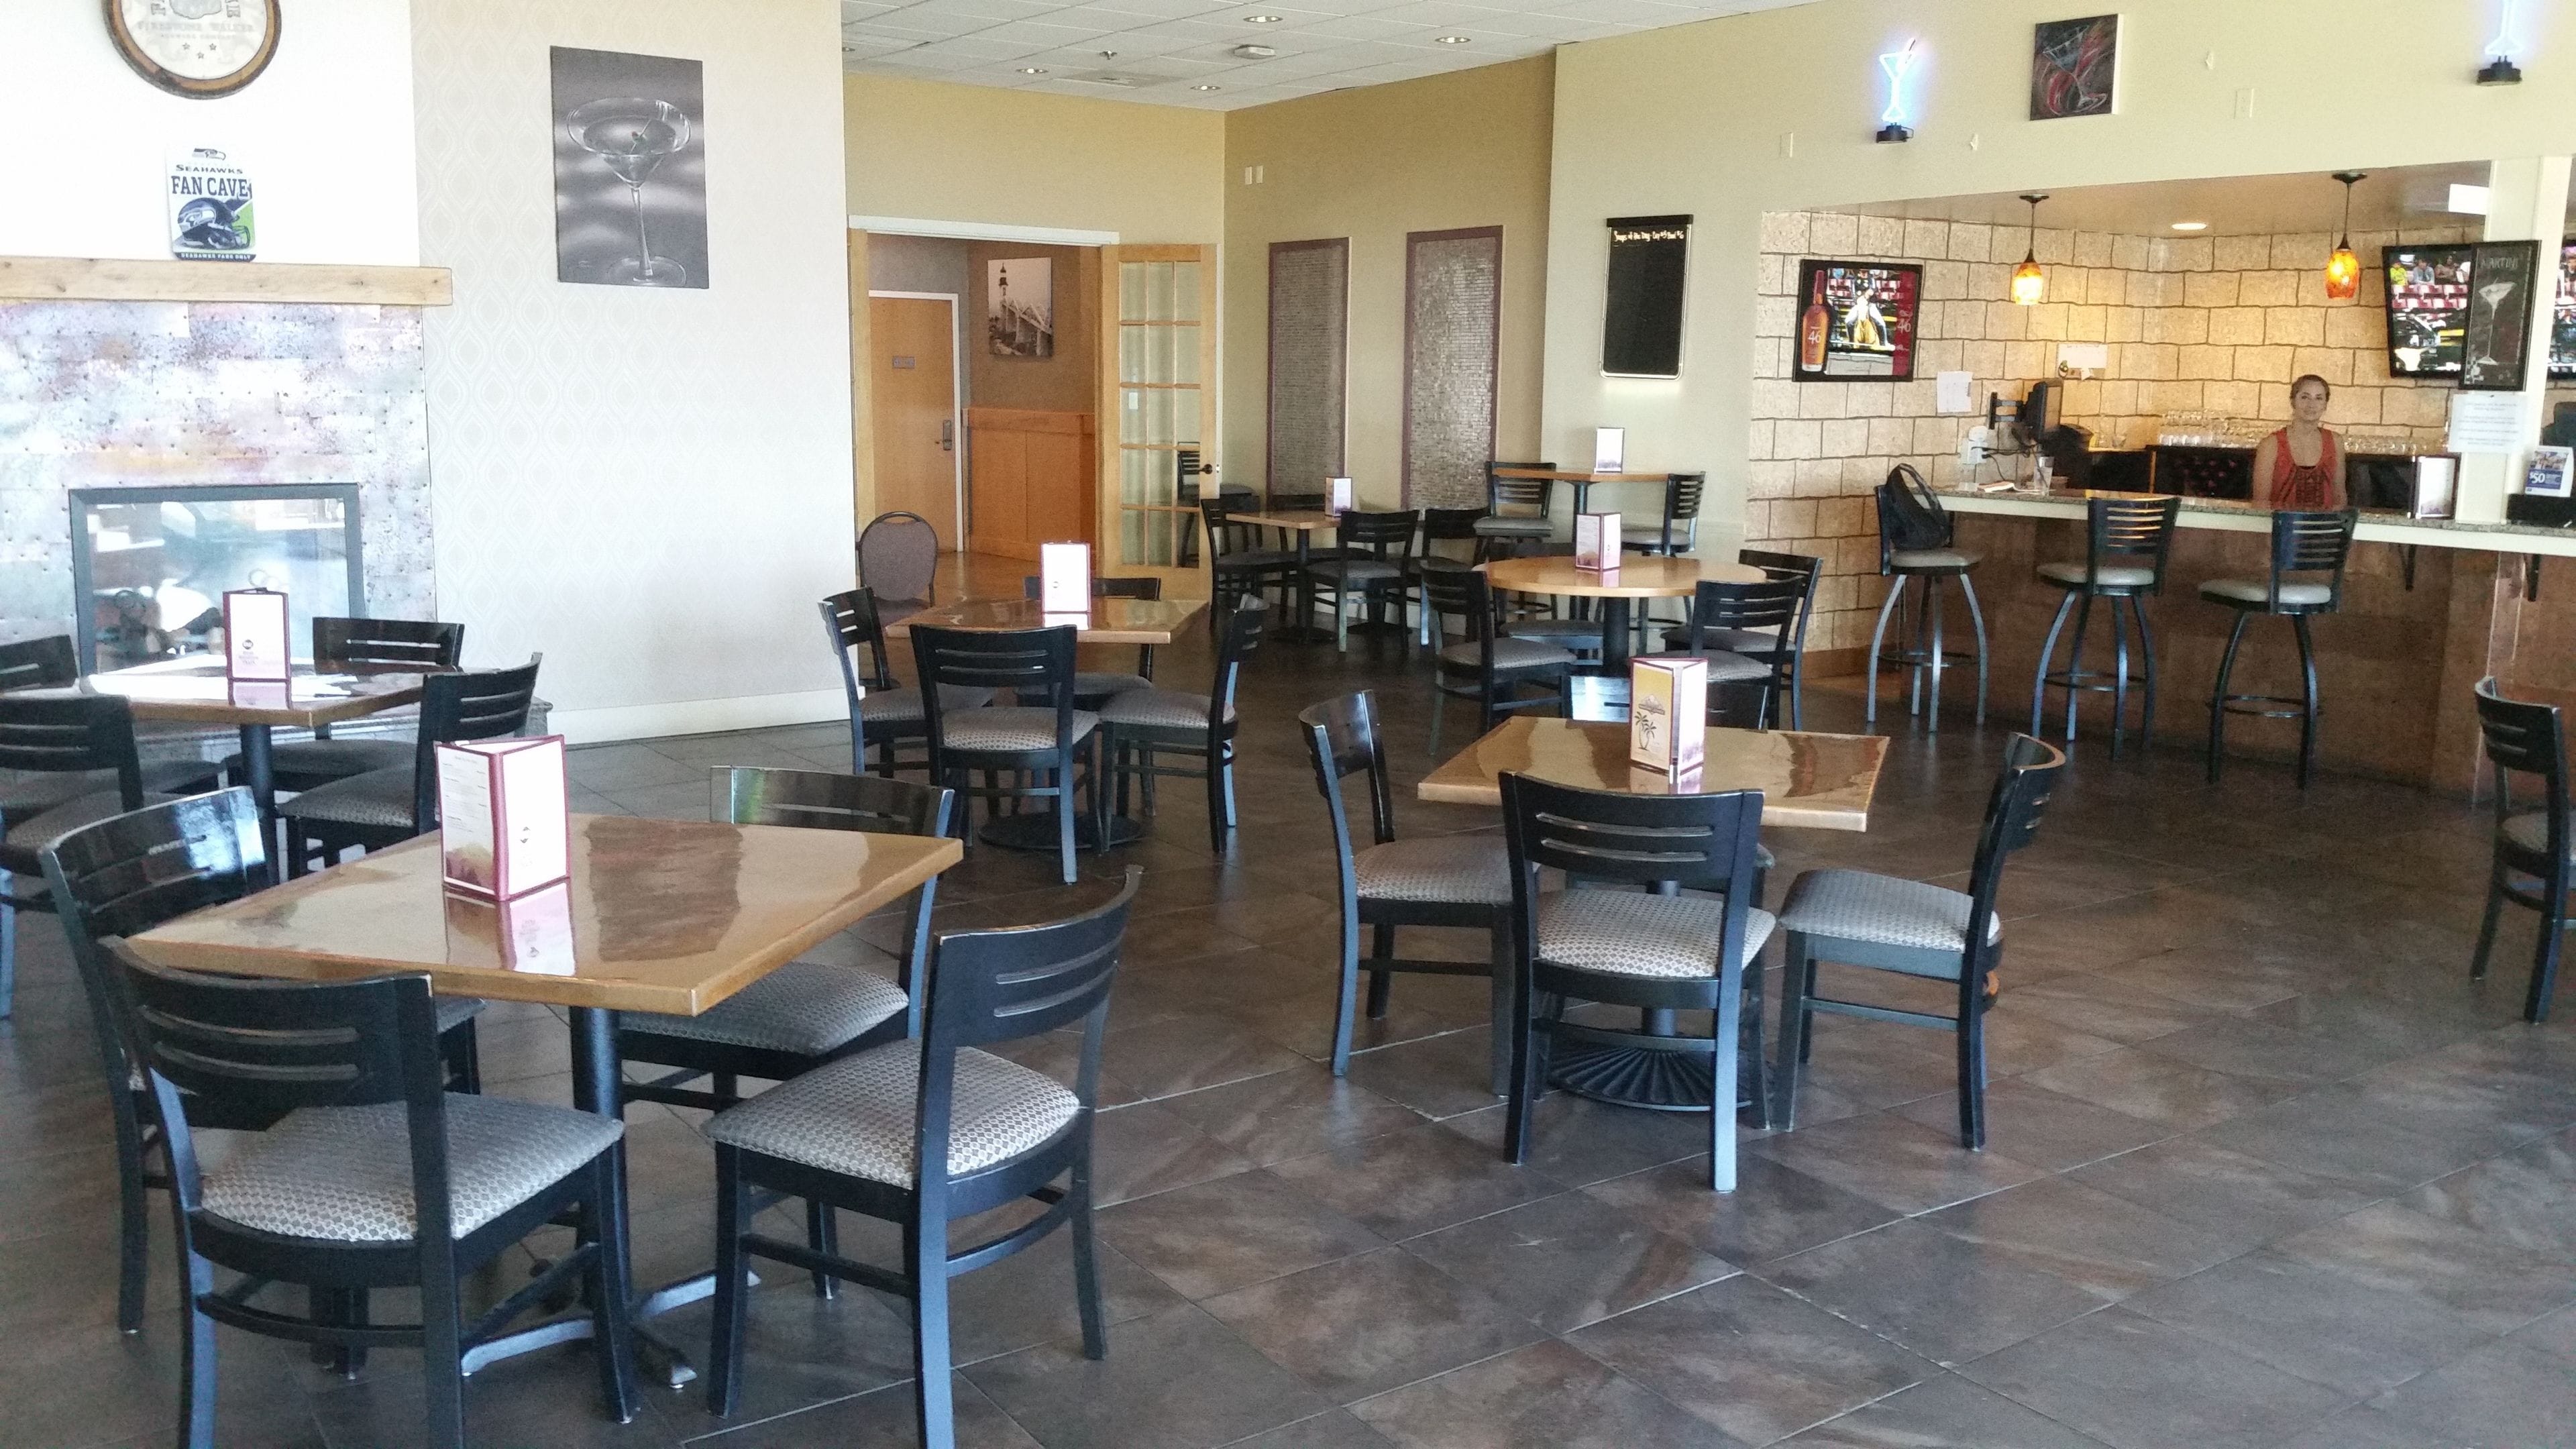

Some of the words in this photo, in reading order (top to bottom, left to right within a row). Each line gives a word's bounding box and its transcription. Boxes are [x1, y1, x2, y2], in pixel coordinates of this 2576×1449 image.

[176, 164, 243, 174] SEAHAWKS
[171, 176, 203, 195] FAN
[207, 177, 248, 197] CAVE
[1897, 318, 1911, 333] 46
[1808, 330, 1822, 344] 46
